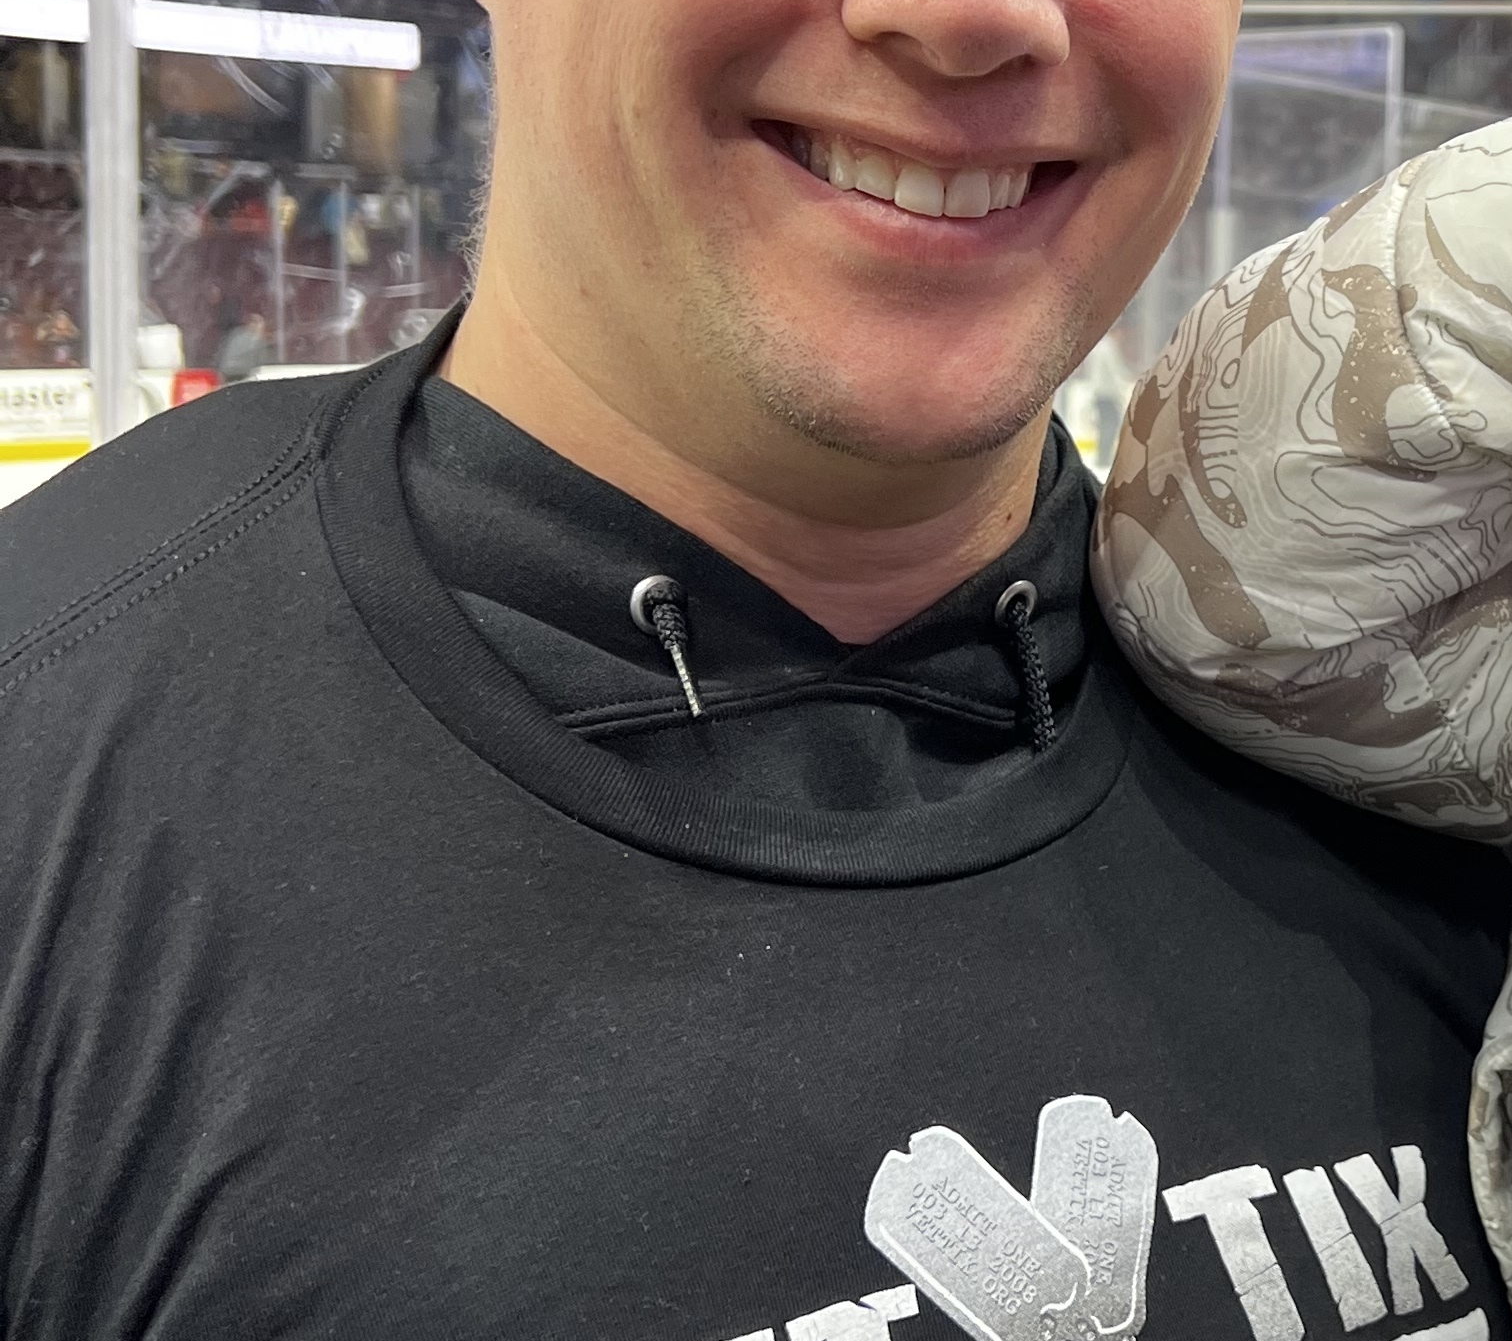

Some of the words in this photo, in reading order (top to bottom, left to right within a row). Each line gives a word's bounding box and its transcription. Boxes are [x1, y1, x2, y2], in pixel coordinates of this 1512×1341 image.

[912, 1182, 949, 1221] 003
[988, 1257, 1038, 1305] 2008
[1003, 1239, 1043, 1281] ONE
